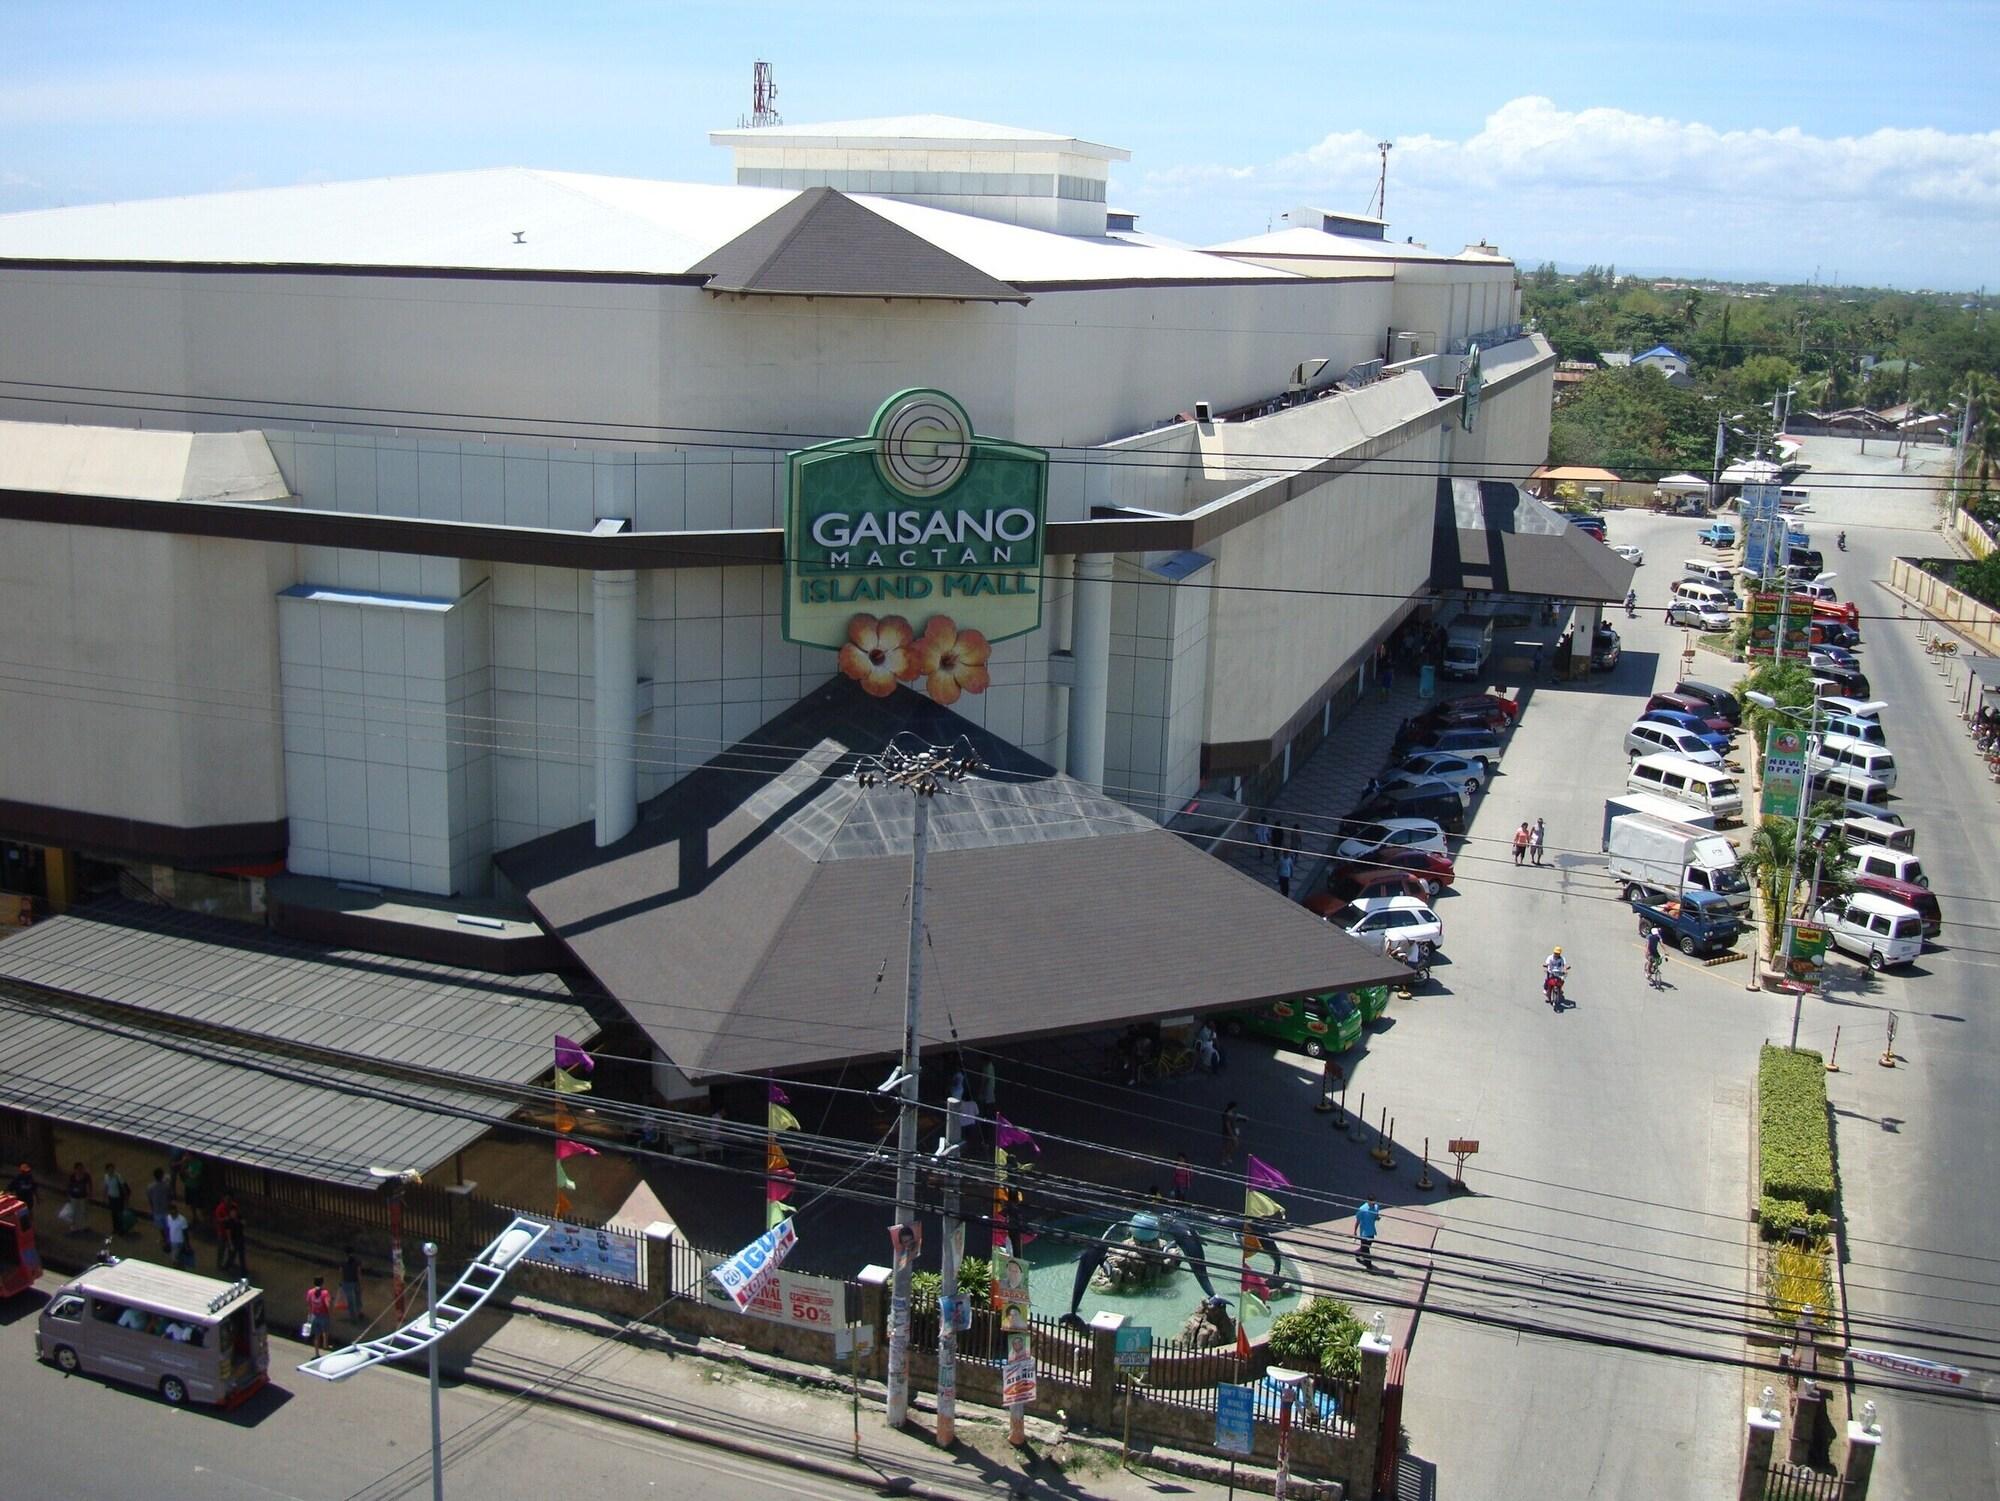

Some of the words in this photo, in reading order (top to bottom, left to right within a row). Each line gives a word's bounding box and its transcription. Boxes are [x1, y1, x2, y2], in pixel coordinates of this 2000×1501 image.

[812, 508, 1036, 547] GAISANO
[831, 546, 1012, 569] MACTAN
[800, 575, 933, 604] ISLAND
[943, 570, 1036, 598] MALL
[1767, 765, 1800, 775] OPEN
[1769, 758, 1799, 767] NOW
